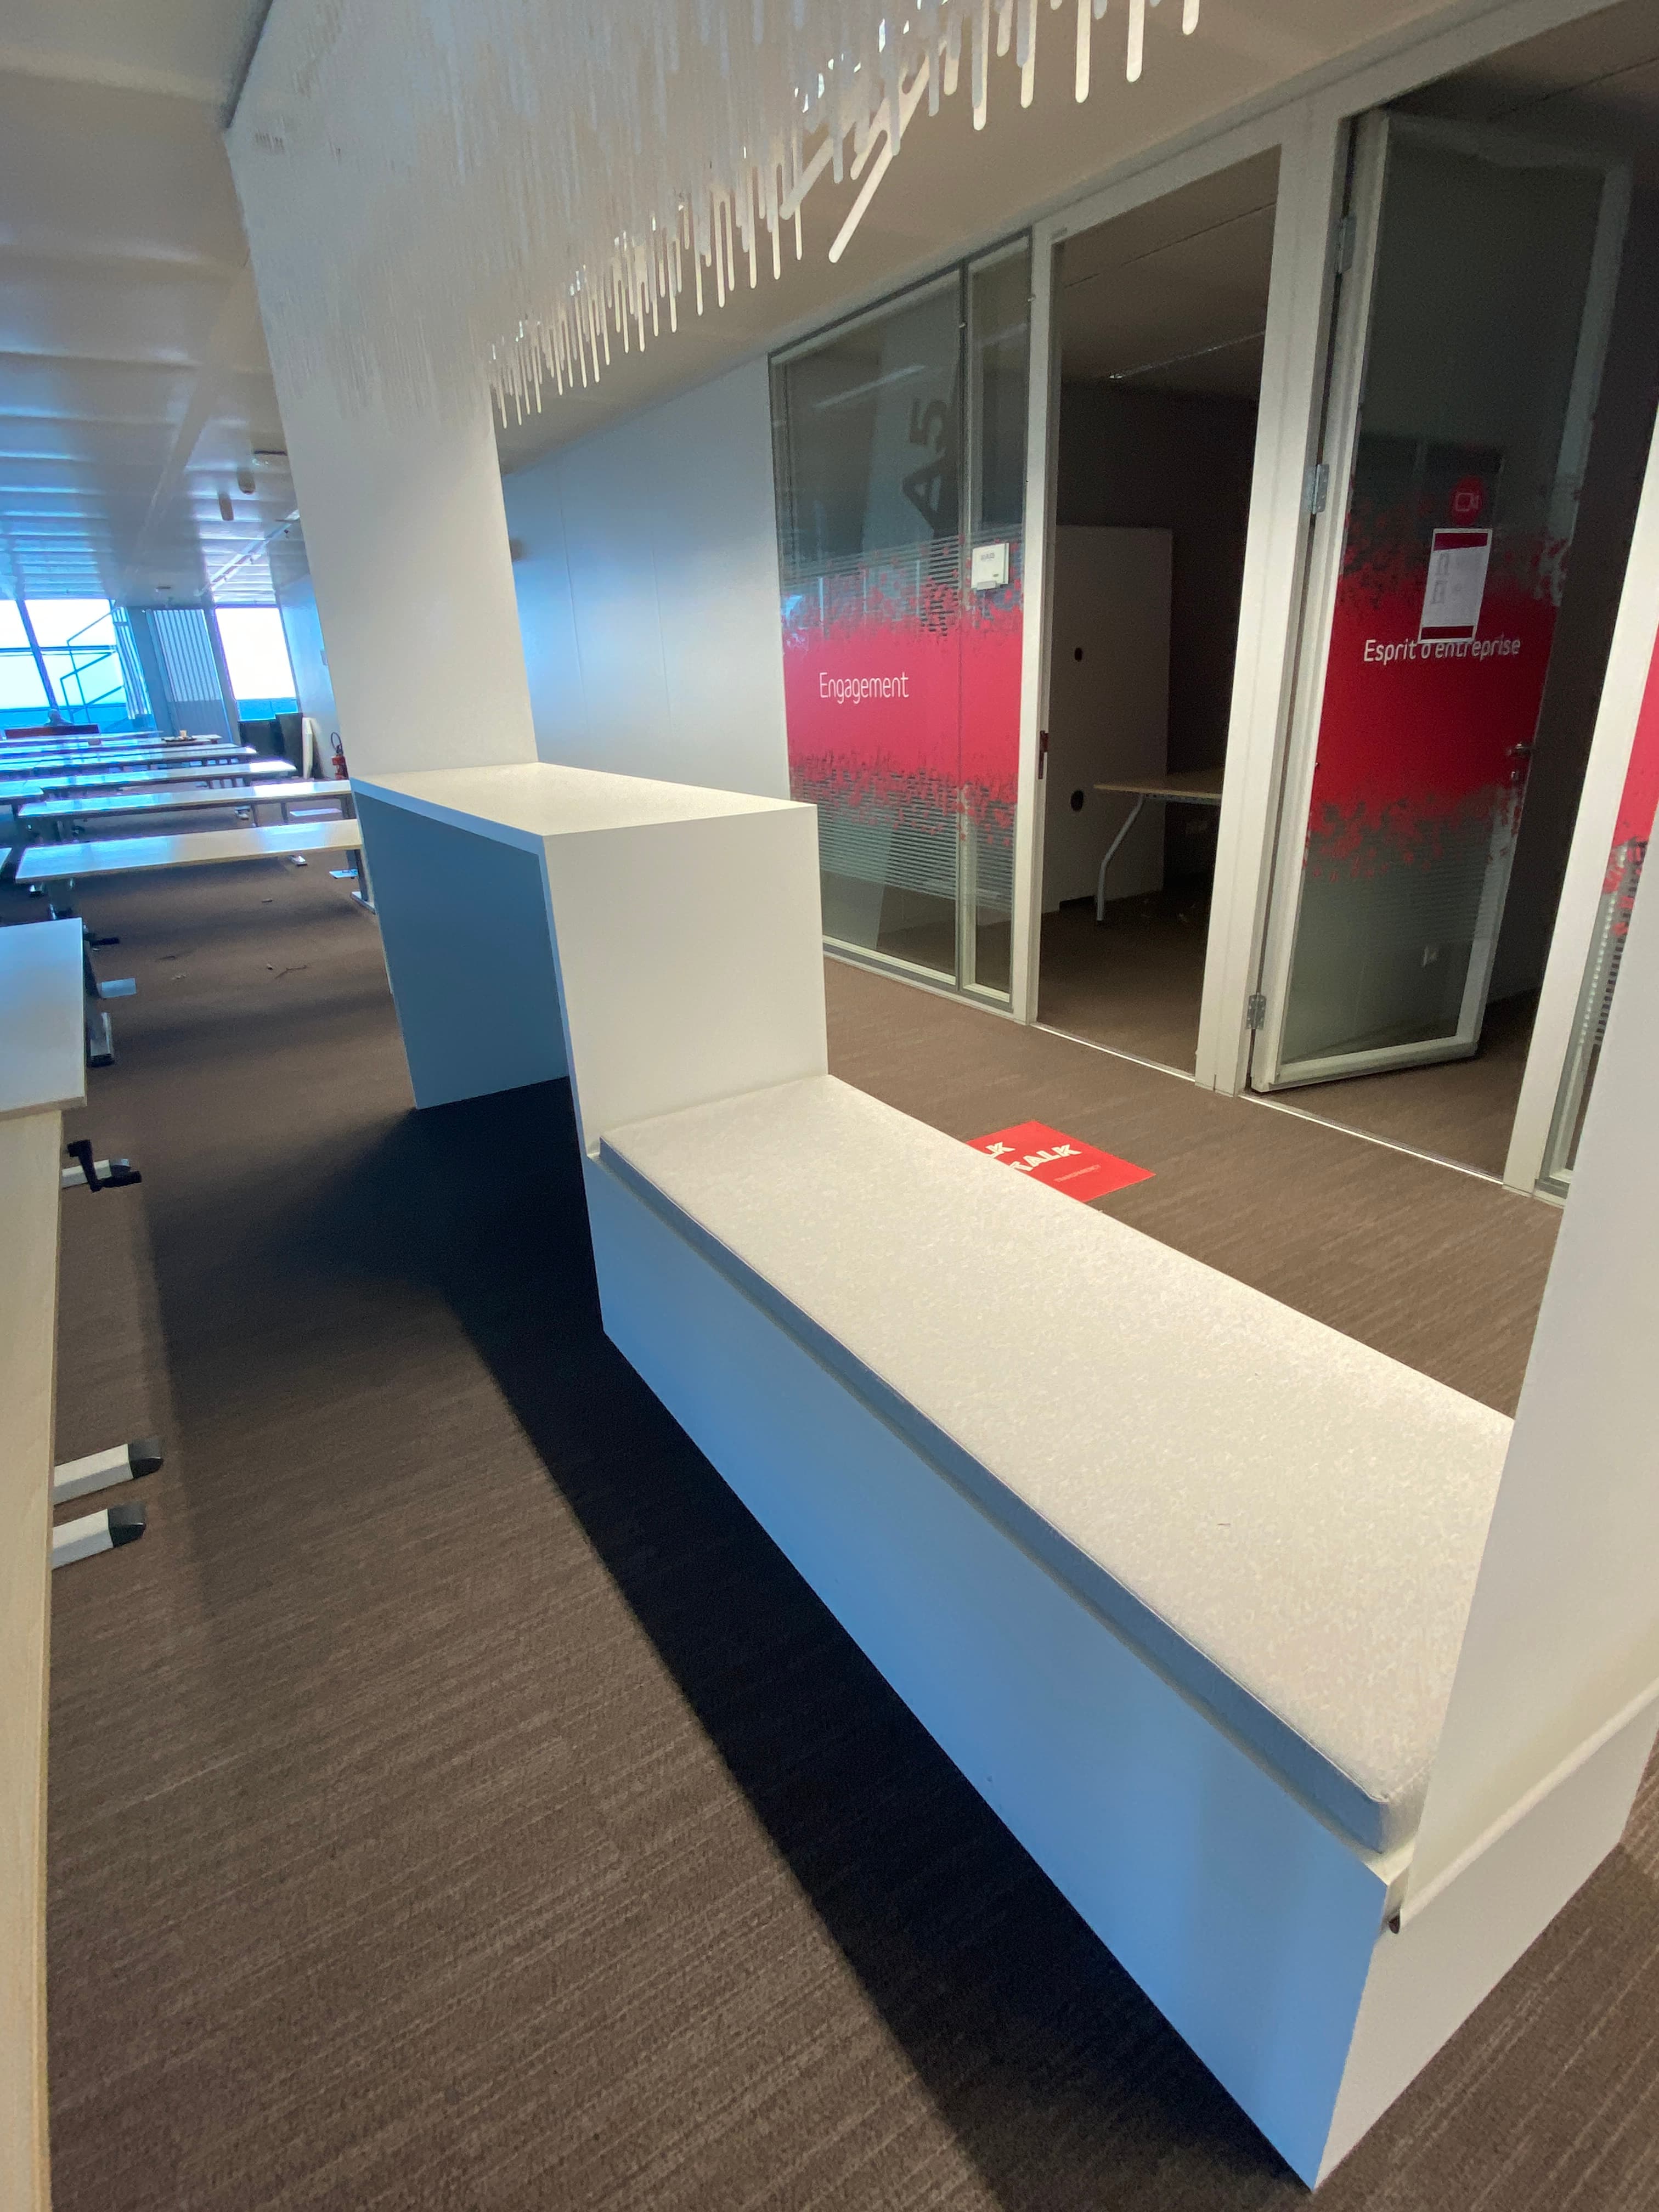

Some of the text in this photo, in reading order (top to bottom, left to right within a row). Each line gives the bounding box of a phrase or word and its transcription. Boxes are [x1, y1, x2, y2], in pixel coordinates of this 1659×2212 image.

[1363, 633, 1521, 665] Esprit dentreprise
[819, 672, 909, 704] Engagement
[1009, 1144, 1082, 1171] TALK
